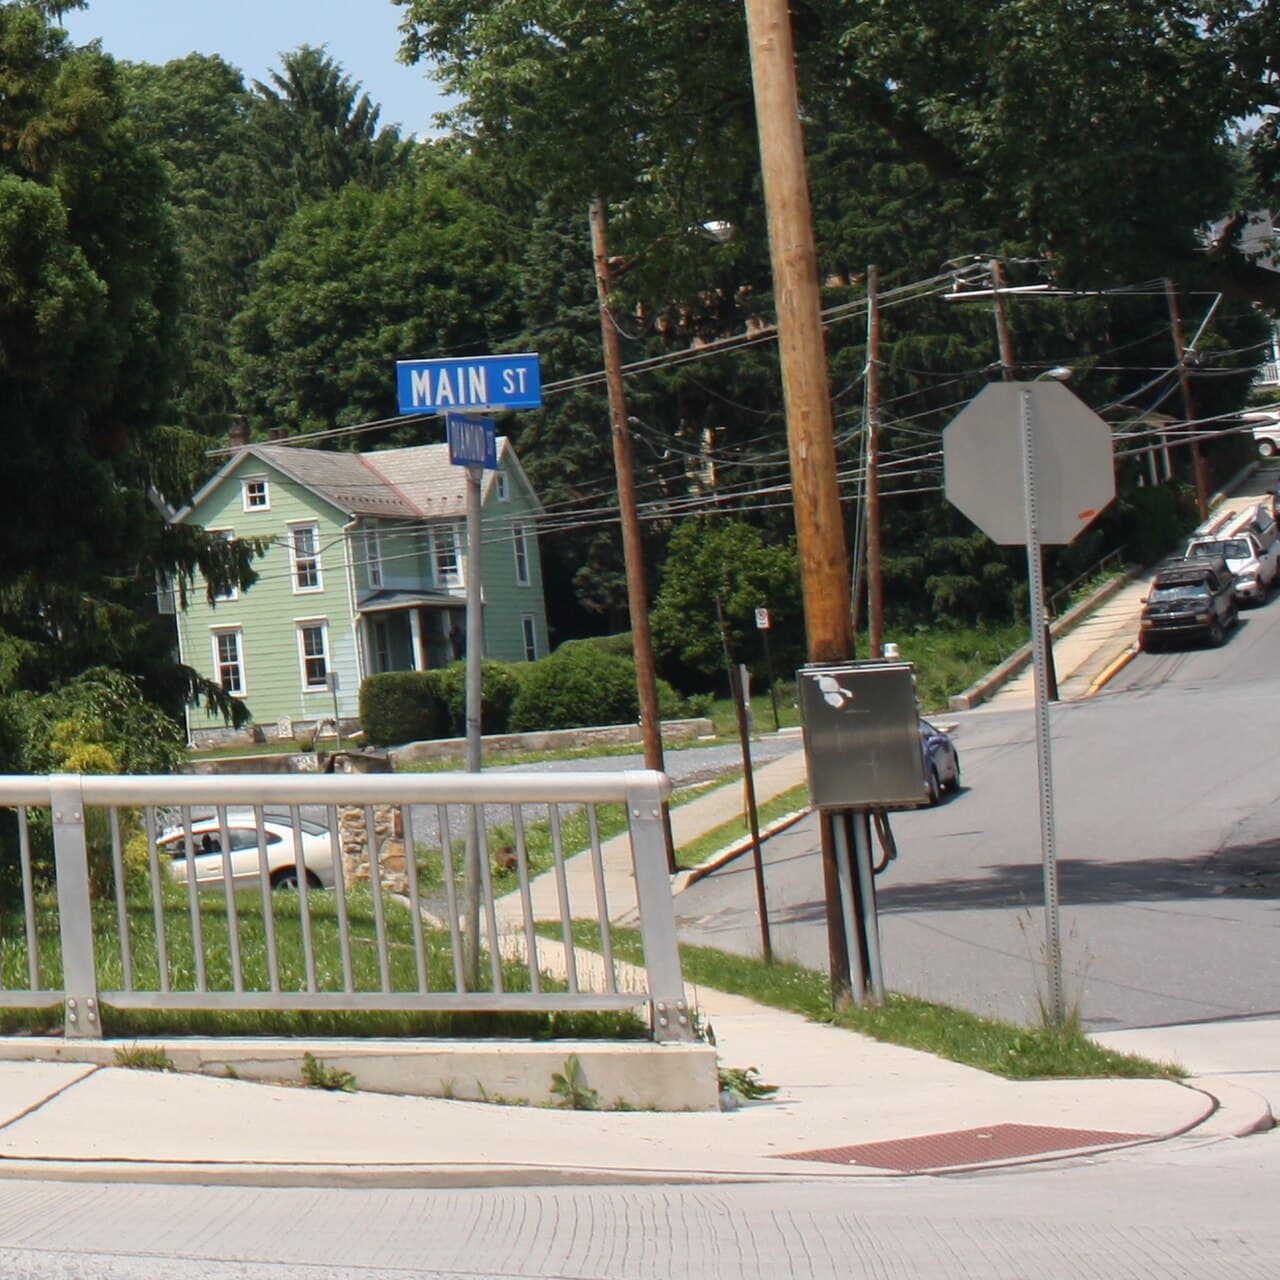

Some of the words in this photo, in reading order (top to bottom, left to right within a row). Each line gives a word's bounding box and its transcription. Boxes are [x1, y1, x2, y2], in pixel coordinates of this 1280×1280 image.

[411, 366, 487, 407] MAIN
[503, 368, 527, 394] ST
[451, 421, 486, 462] DIAMOND
